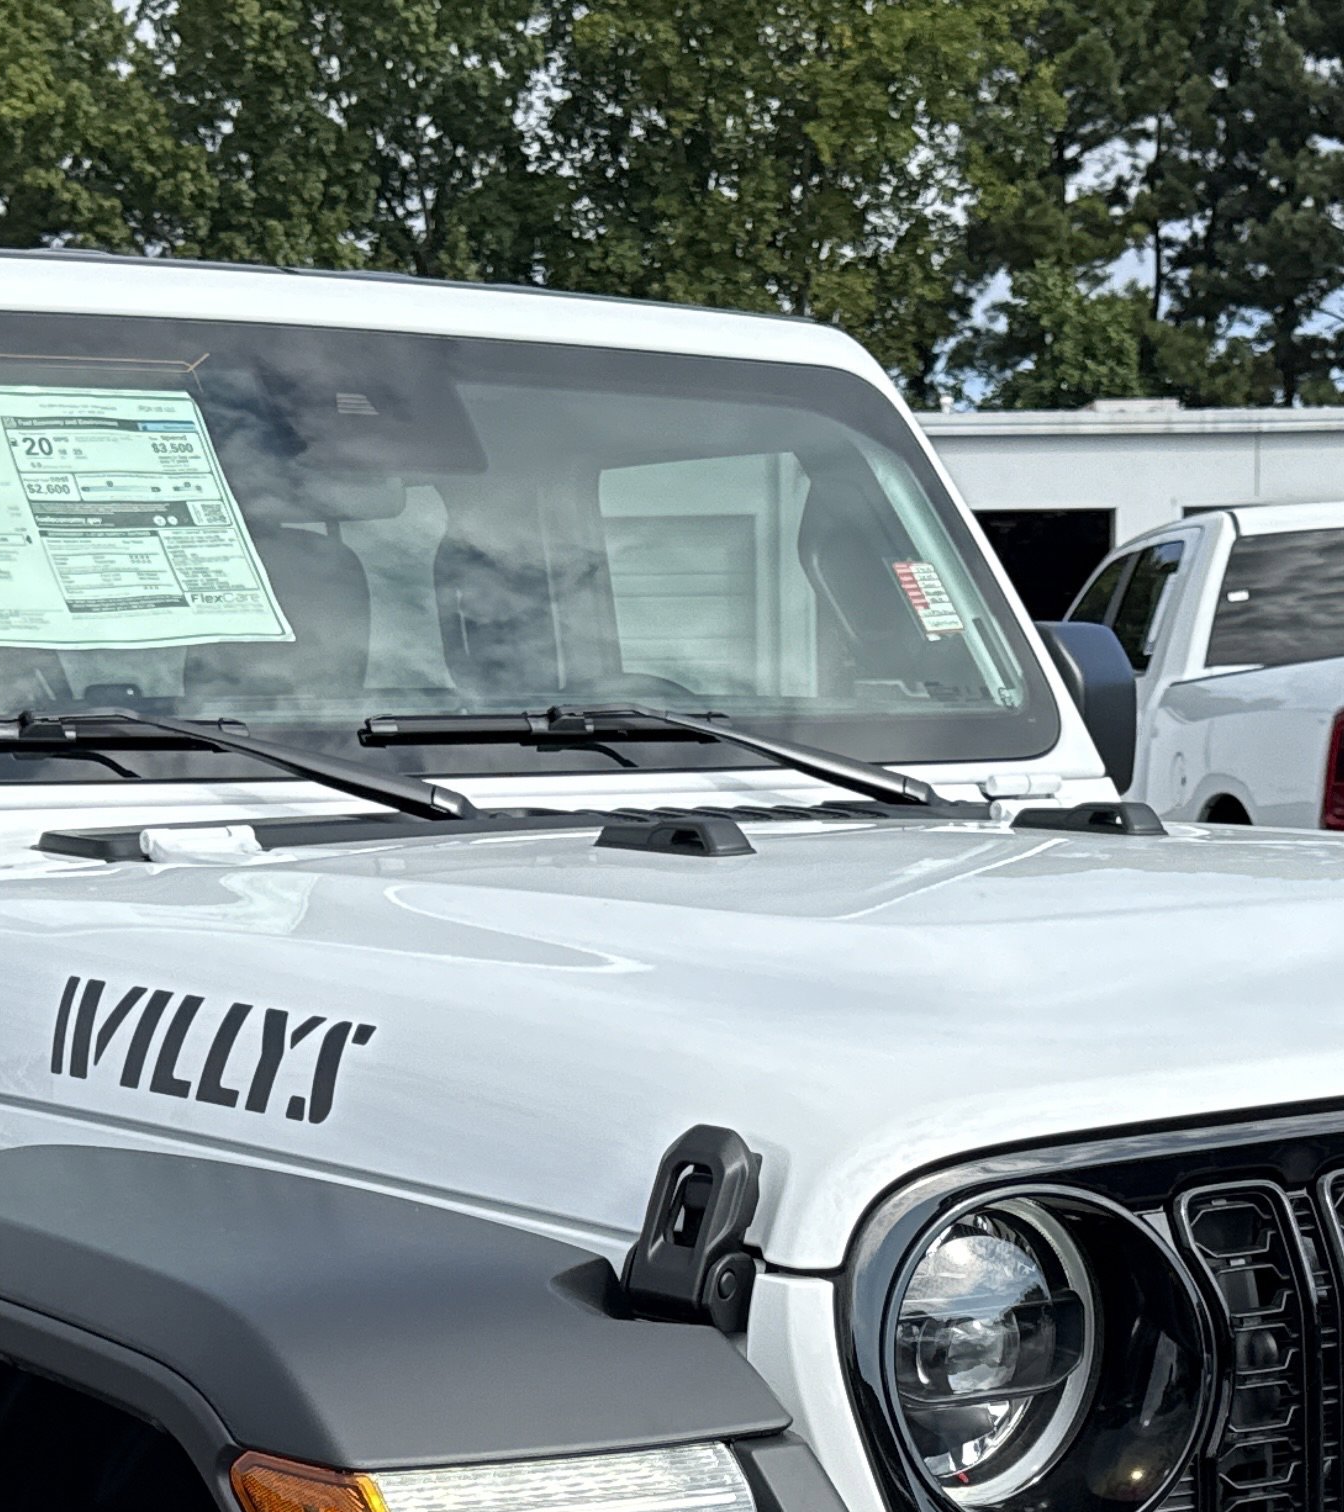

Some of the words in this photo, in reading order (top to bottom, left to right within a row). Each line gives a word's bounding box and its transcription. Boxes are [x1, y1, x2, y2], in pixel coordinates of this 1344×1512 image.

[160, 434, 187, 443] spend
[21, 437, 53, 456] 20
[151, 442, 194, 454] $3,500
[49, 475, 69, 483] cost
[26, 483, 70, 495] $2,600
[190, 592, 261, 604] FlexCare
[50, 975, 378, 1125] WILLYS
